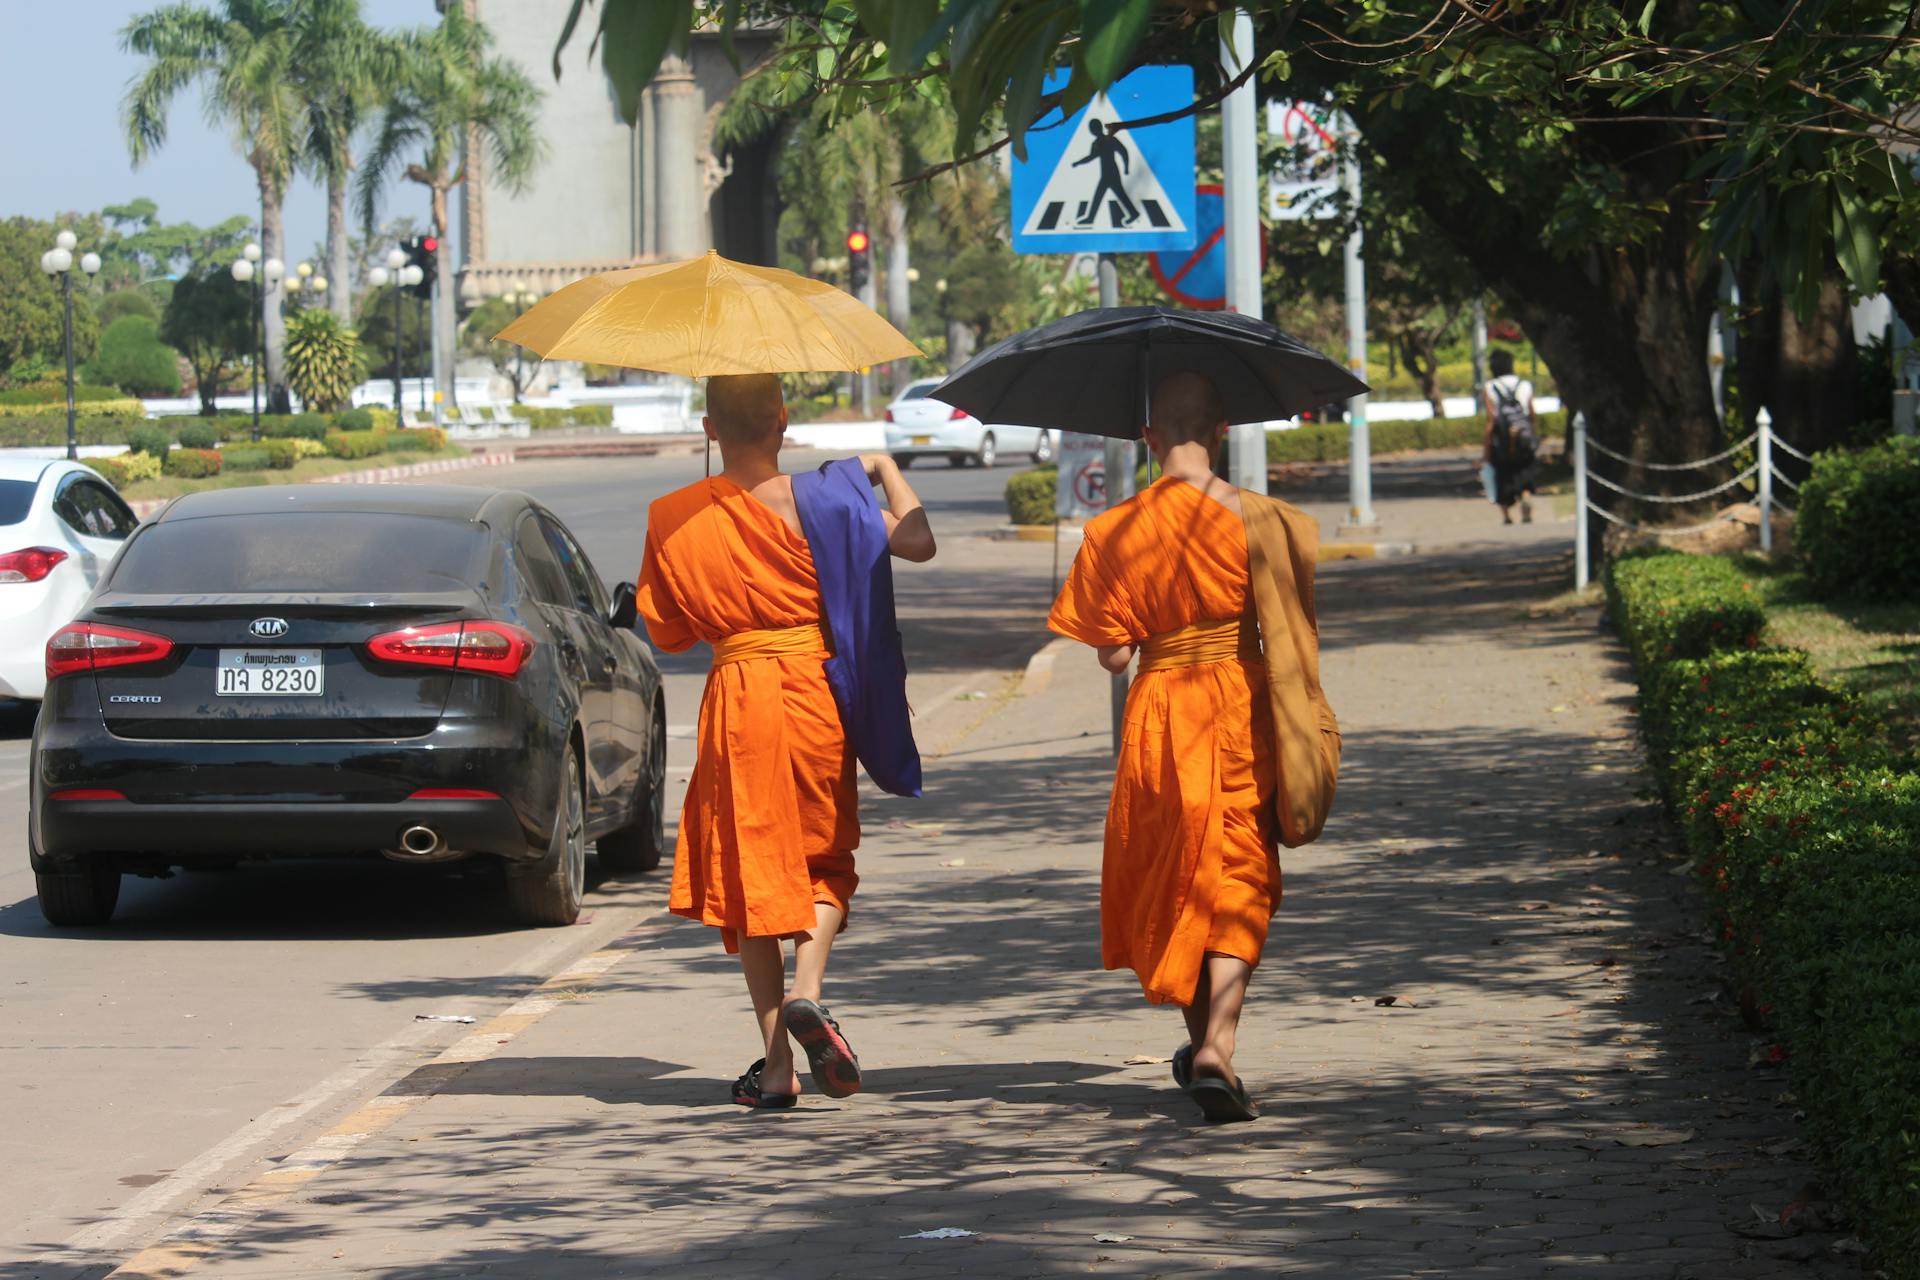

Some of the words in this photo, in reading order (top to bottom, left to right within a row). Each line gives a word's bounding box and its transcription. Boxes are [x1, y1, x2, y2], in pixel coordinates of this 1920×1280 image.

[255, 622, 283, 634] KIA
[262, 669, 317, 691] 8230
[110, 695, 162, 704] CERATO
